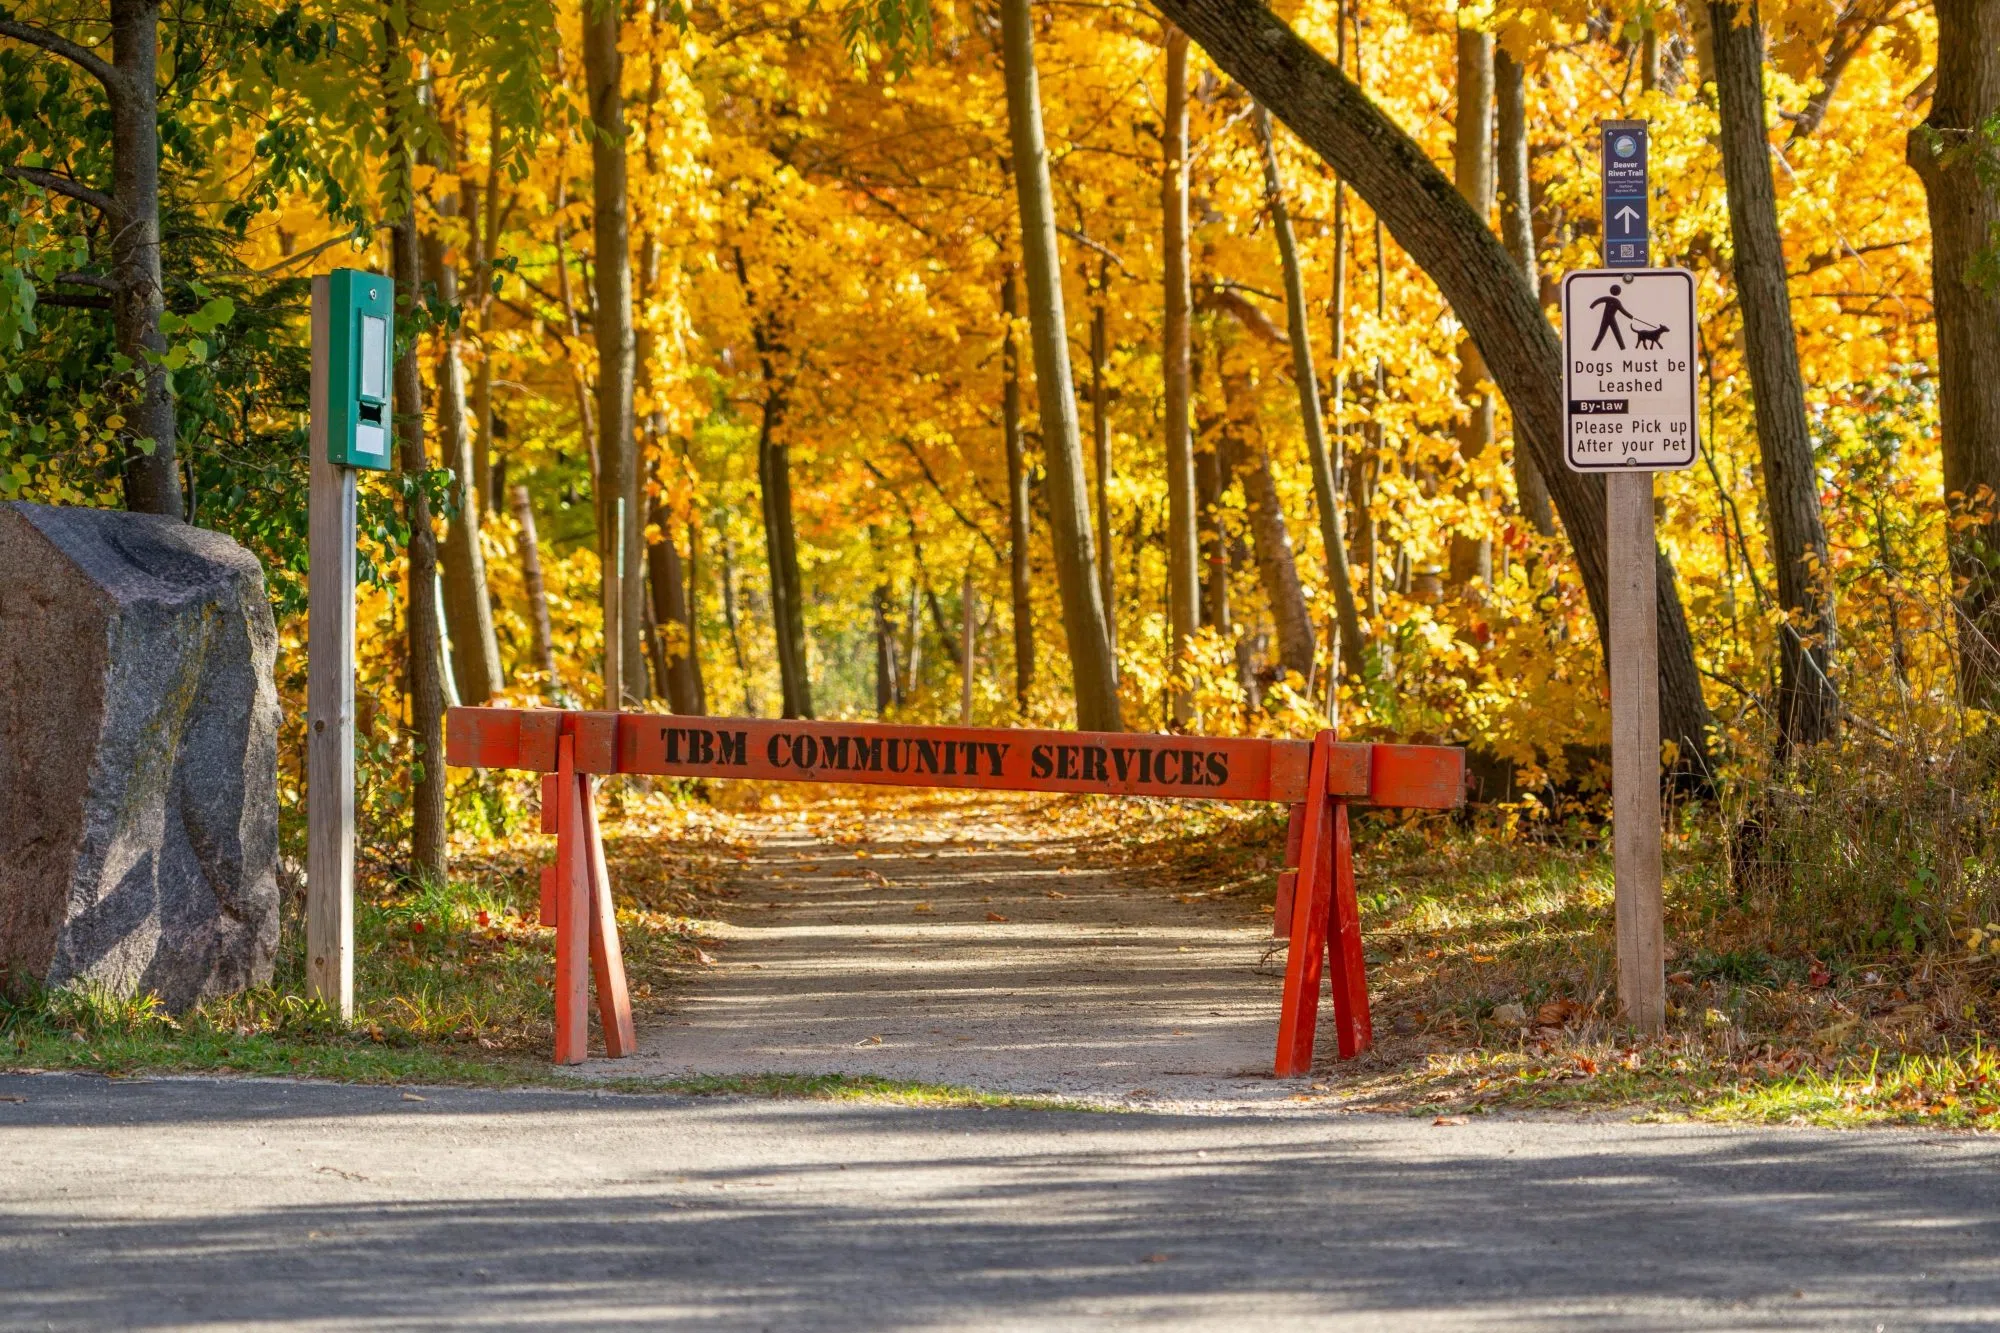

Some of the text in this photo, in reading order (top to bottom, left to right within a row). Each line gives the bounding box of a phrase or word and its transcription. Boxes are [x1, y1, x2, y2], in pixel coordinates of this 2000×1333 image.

[1575, 359, 1686, 376] Dogs Must be
[1599, 378, 1663, 392] Leashed
[1580, 402, 1624, 412] By-law
[1575, 419, 1687, 435] Please Pick up
[1577, 438, 1686, 455] After your Pet
[660, 728, 1229, 787] TBM COMMUNITY SERVICES
